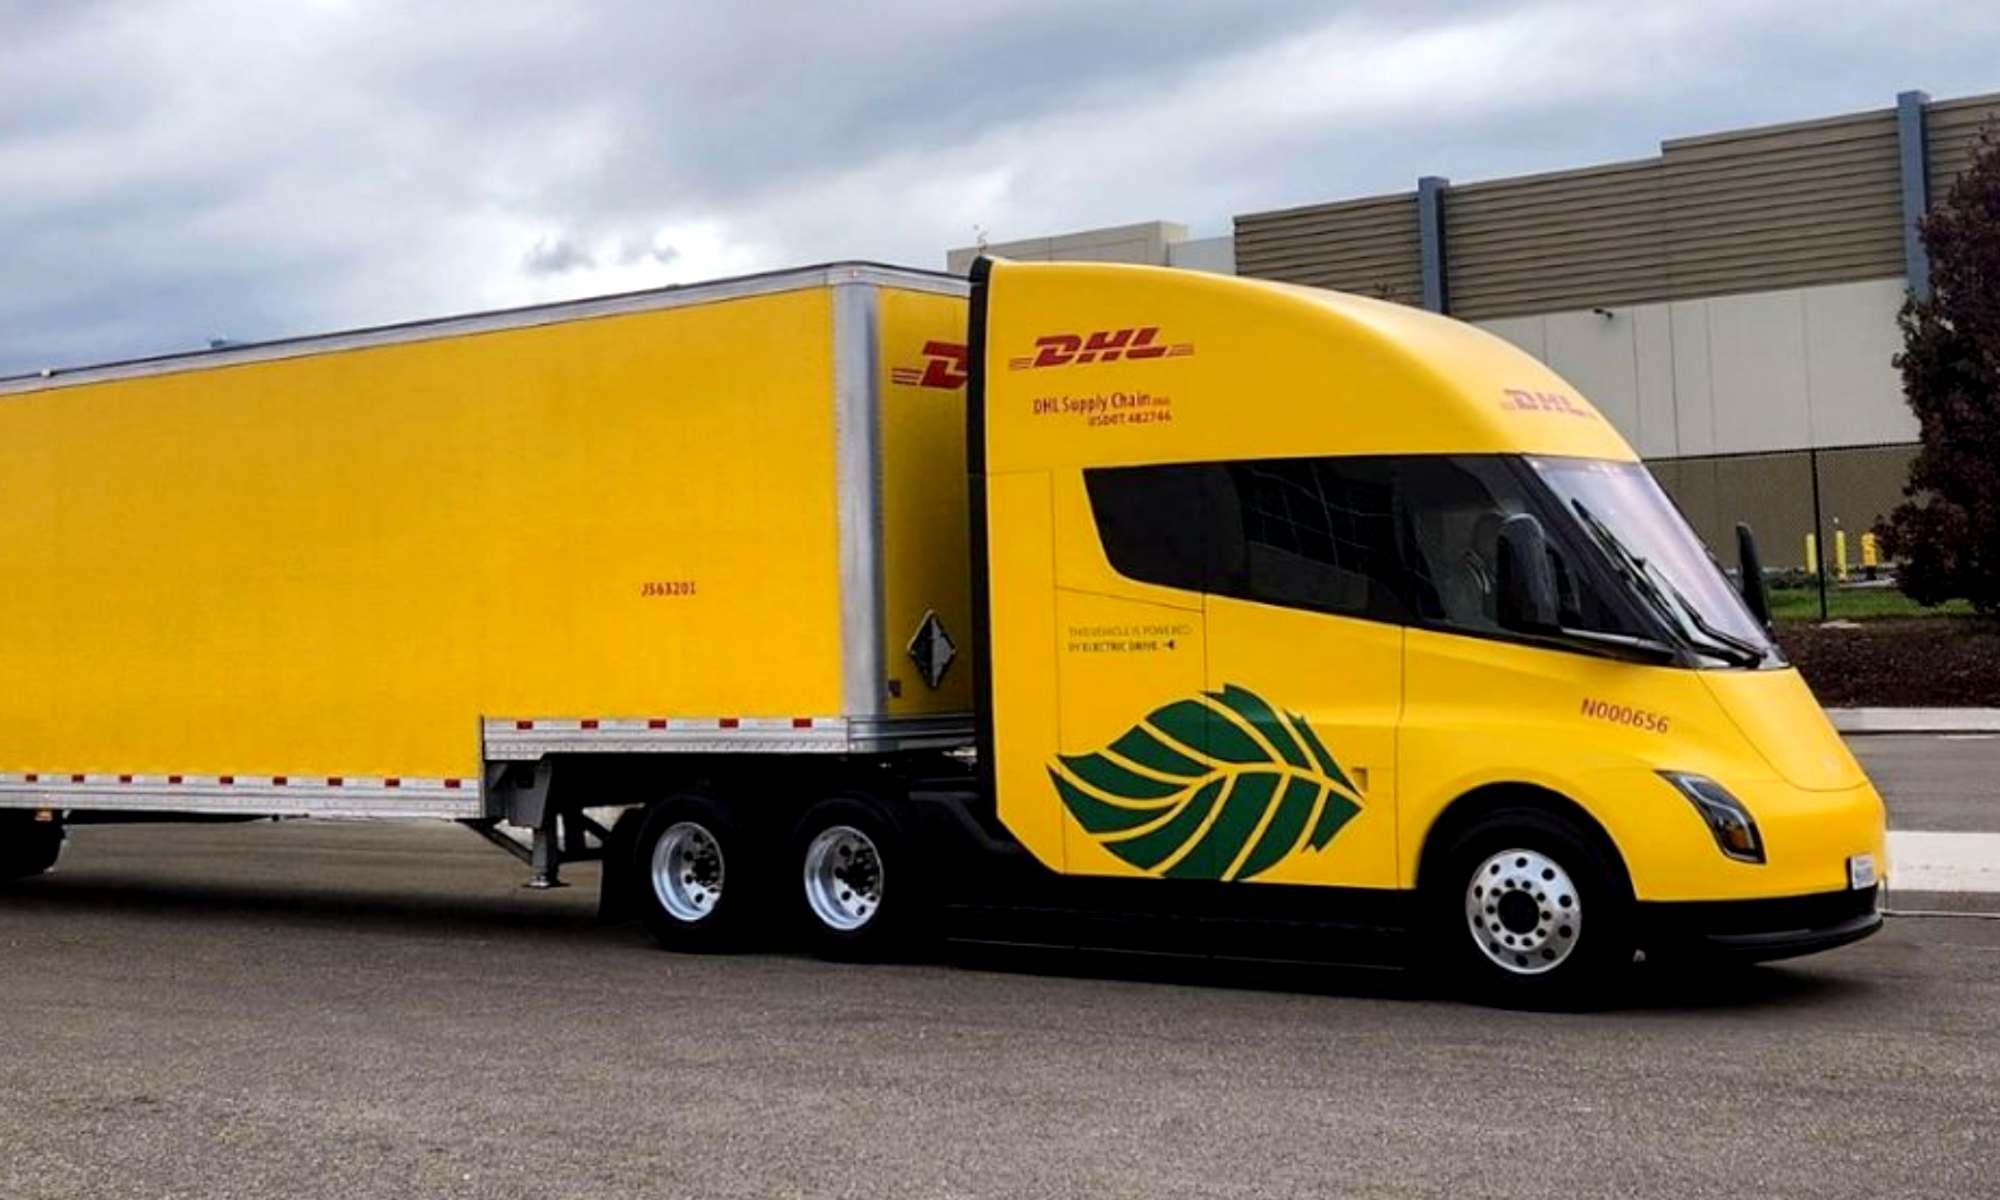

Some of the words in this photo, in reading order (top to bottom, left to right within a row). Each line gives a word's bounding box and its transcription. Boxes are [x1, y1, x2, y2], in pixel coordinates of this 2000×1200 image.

[1032, 328, 1168, 369] DHL
[1032, 398, 1060, 415] DHL
[1062, 395, 1107, 414] Supply
[1111, 391, 1150, 408] Chain
[1503, 389, 1585, 416] DHL
[1088, 412, 1125, 427] USDOT
[1082, 641, 1127, 653] ELECTRIC
[1129, 639, 1158, 652] DRIVE
[1581, 698, 1670, 734] N000656
